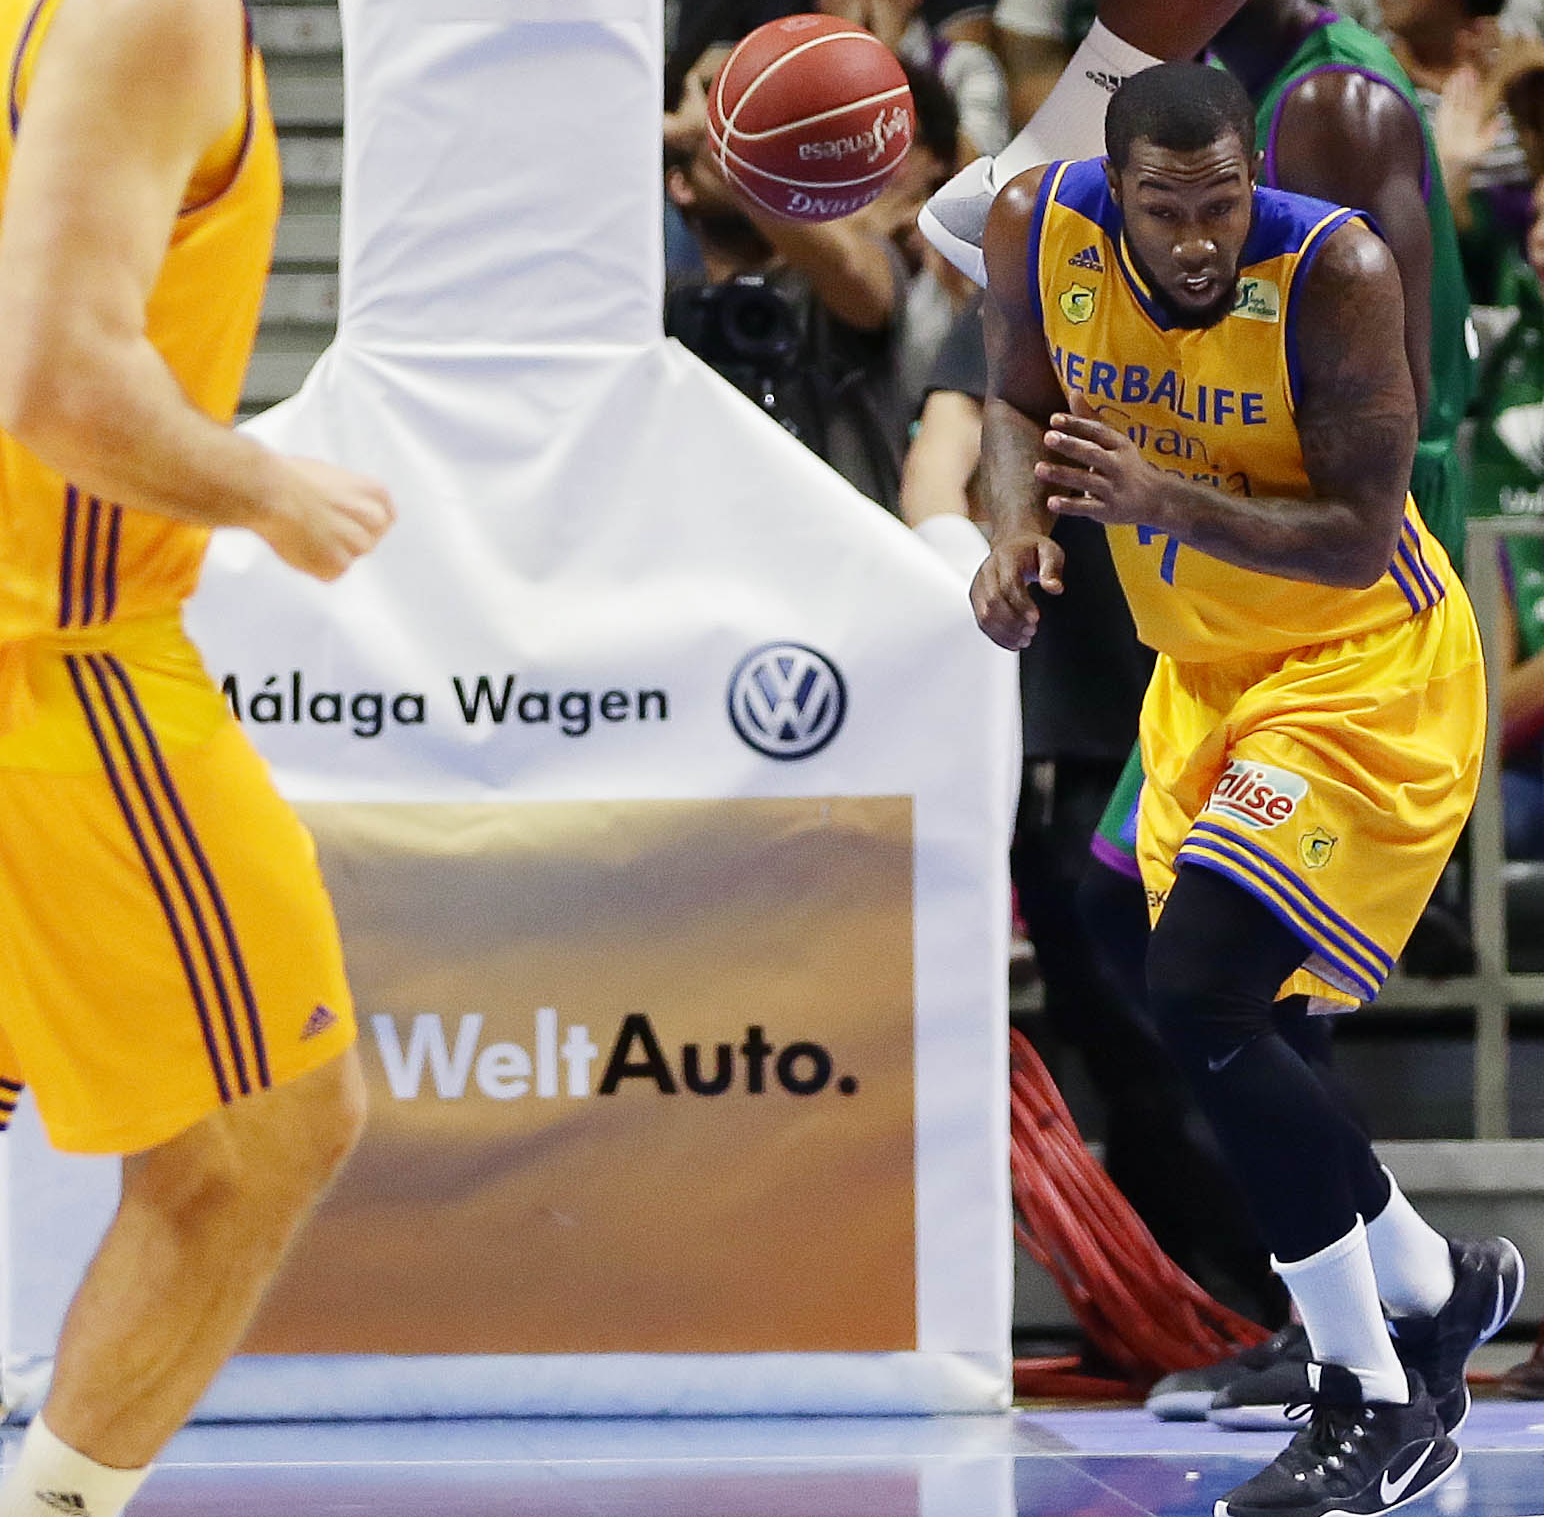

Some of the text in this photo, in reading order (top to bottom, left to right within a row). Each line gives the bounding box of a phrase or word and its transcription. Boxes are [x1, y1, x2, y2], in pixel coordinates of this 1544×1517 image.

[453, 673, 669, 737] Wagen
[1207, 761, 1293, 821] alise
[371, 1007, 860, 1100] WeltAuto.
